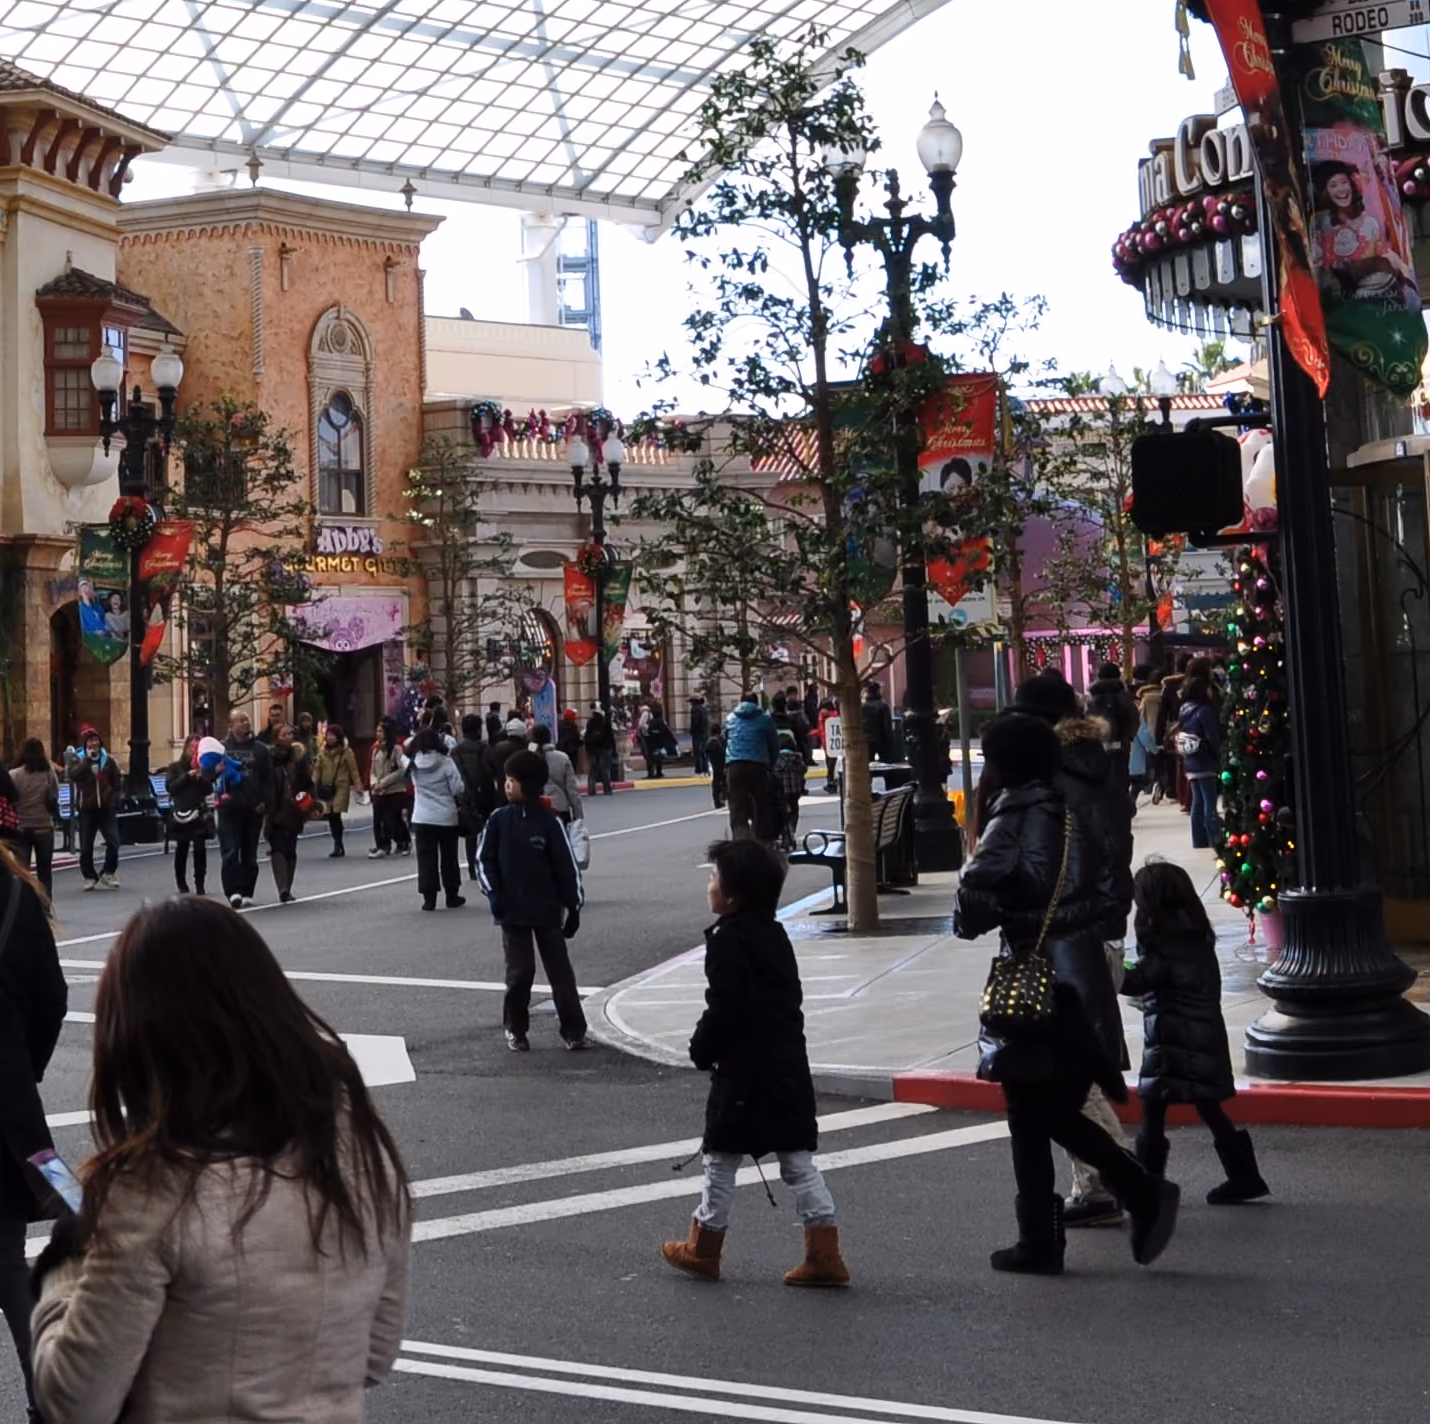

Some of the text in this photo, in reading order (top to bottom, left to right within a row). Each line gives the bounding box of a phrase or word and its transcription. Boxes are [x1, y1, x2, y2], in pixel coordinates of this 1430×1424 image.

[1332, 7, 1389, 35] RODEO
[1324, 43, 1363, 81] Merry
[926, 435, 988, 450] Christmas
[282, 556, 360, 572] GURMET
